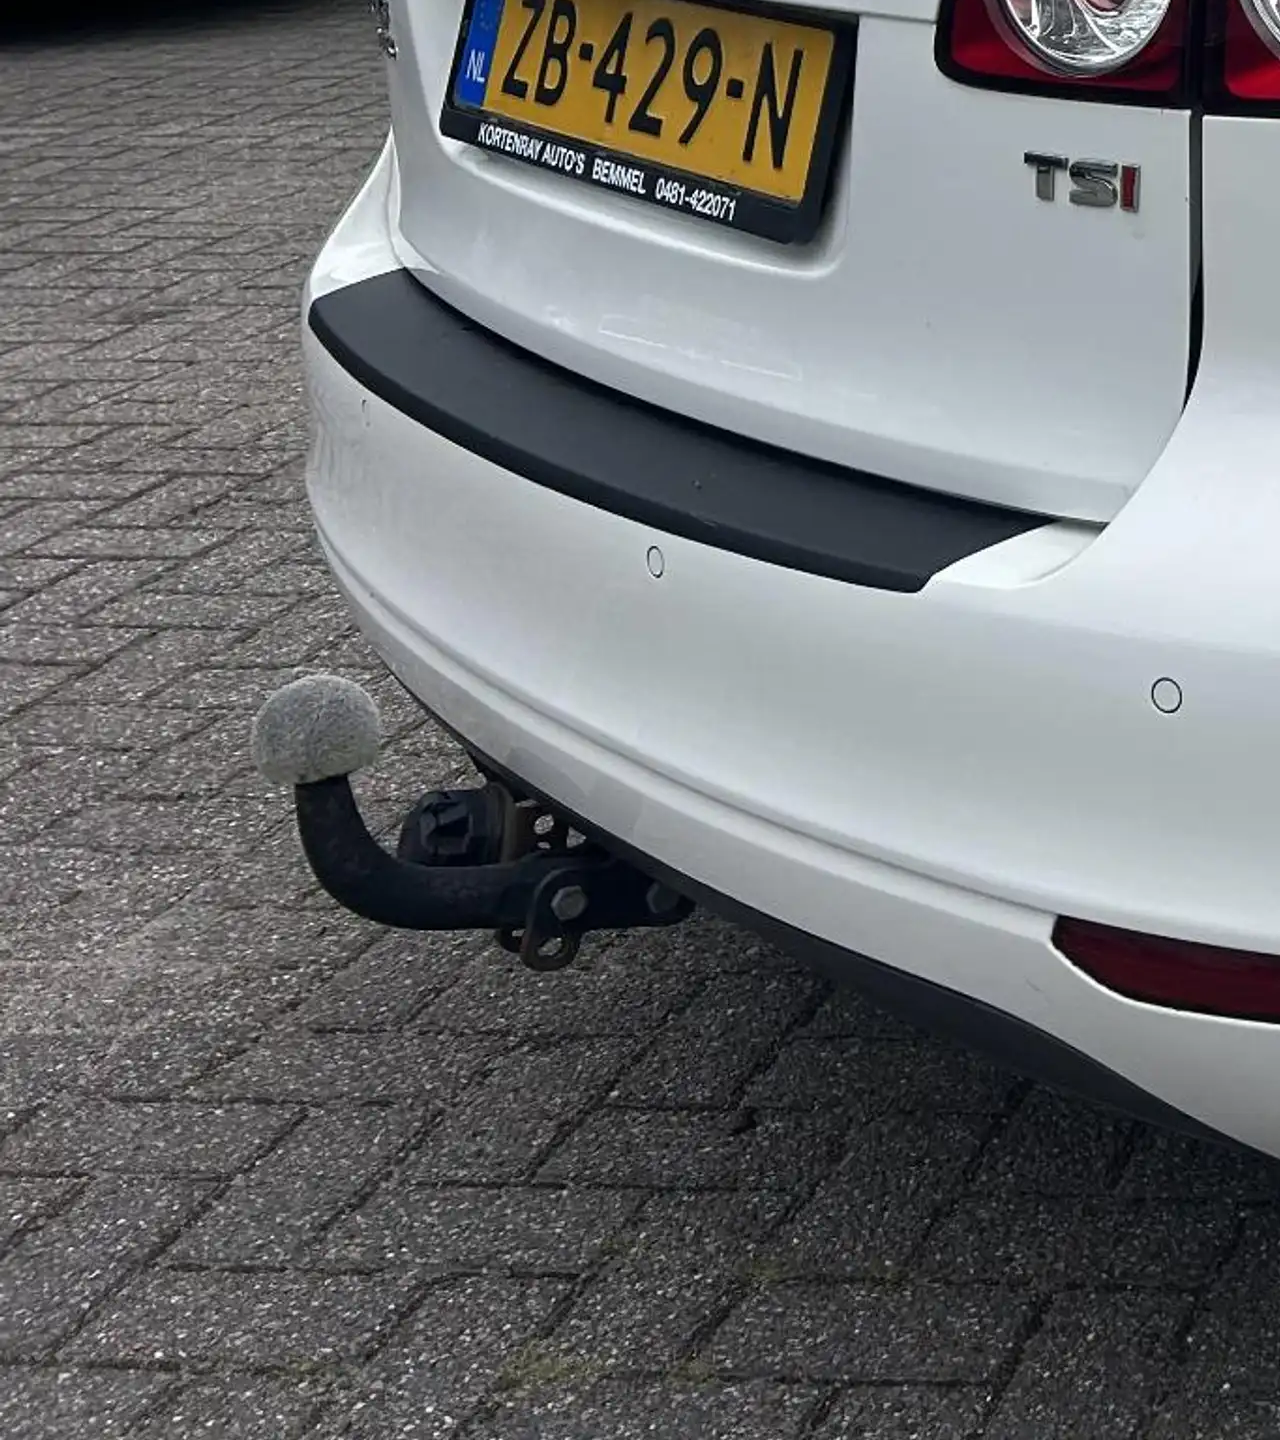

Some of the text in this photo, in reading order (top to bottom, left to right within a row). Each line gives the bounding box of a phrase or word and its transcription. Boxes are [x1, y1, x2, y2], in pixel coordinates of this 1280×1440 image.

[465, 49, 486, 83] NL
[478, 122, 737, 221] KORTENRAY AUTO'S BEMMEL 0481-422071
[1024, 151, 1141, 213] TSI
